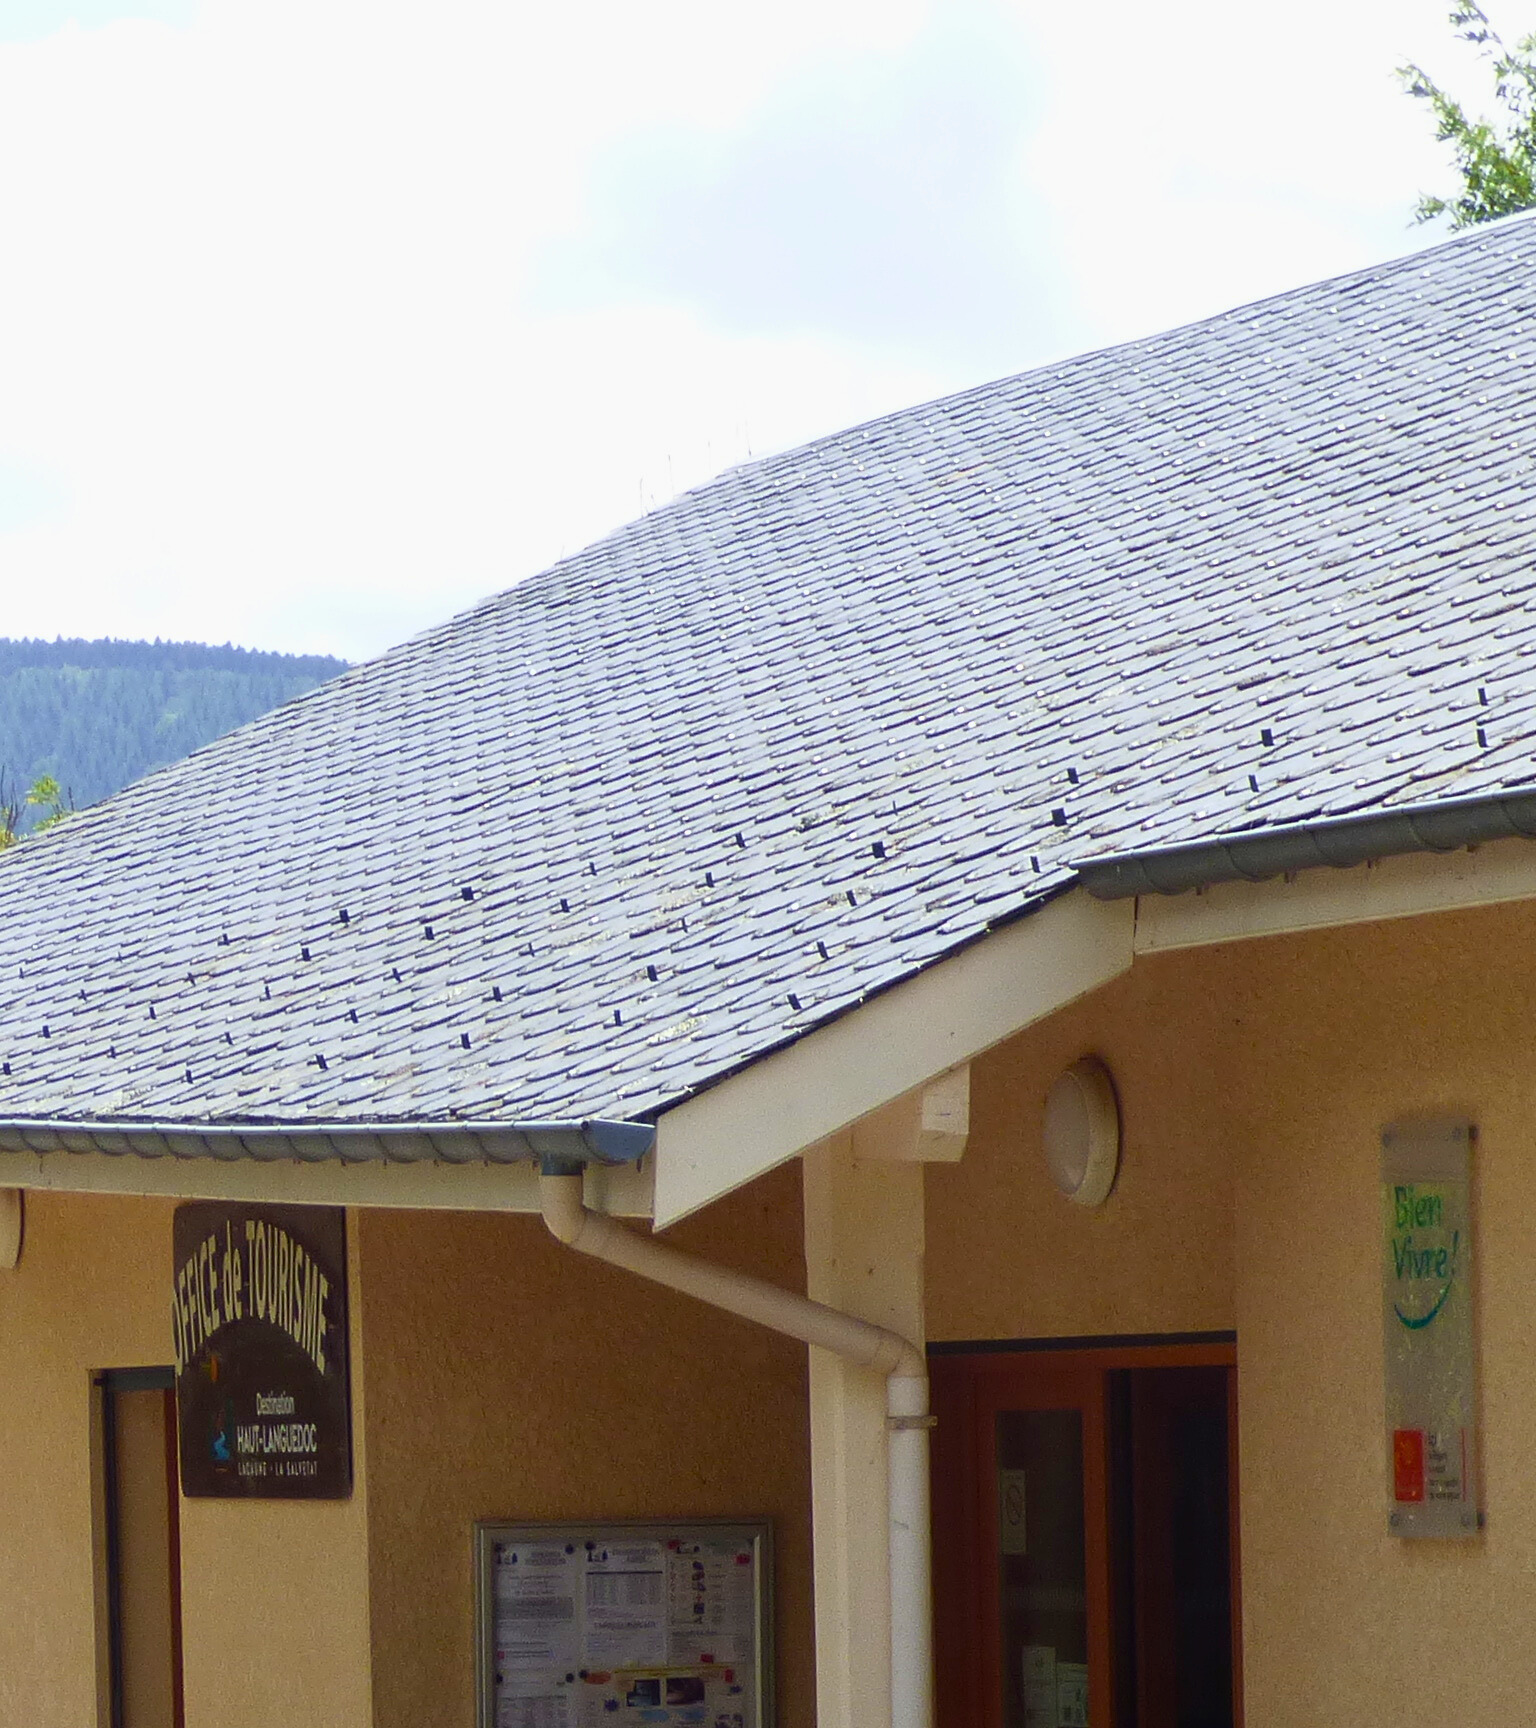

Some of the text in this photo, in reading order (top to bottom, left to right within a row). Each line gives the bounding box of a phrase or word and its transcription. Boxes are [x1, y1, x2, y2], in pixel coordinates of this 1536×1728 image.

[1394, 1185, 1442, 1229] Bien
[172, 1219, 328, 1377] OFFICE de TOURISME
[256, 1390, 295, 1416] Destination
[237, 1423, 317, 1453] HAUT-LANGUEDOC
